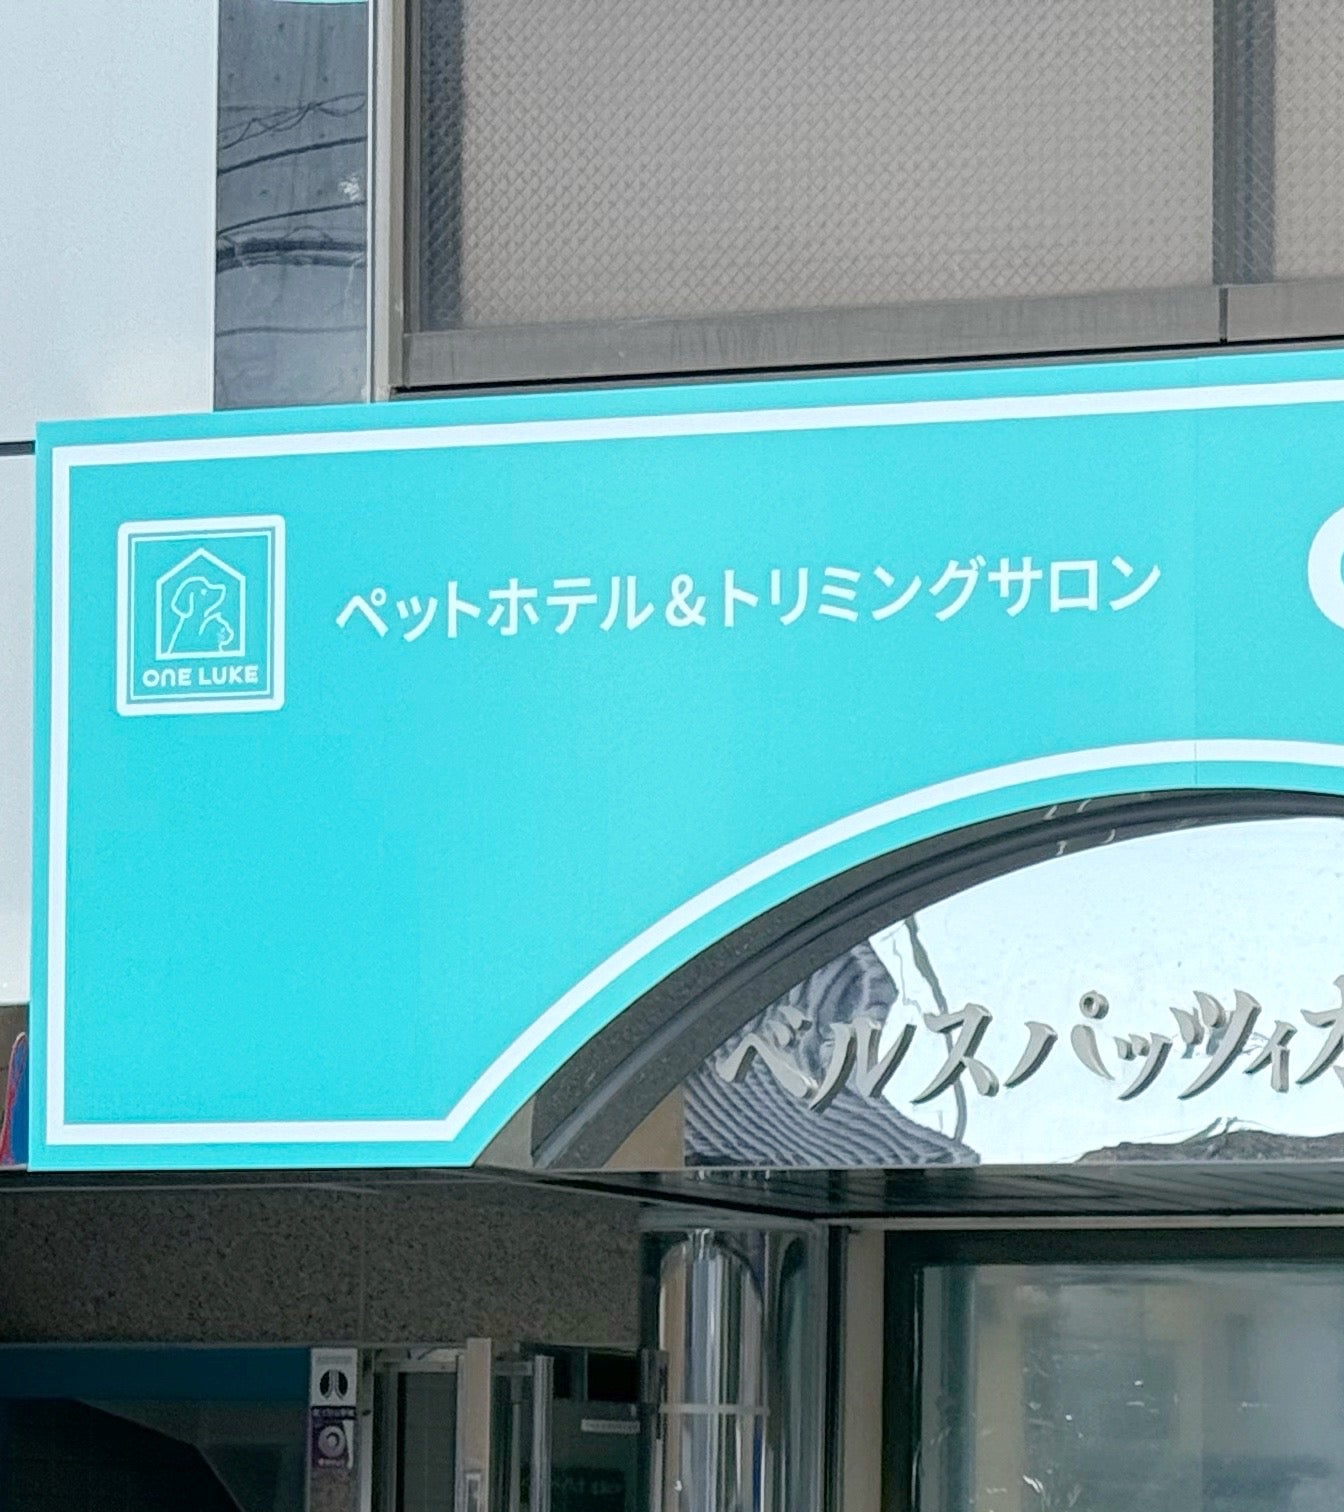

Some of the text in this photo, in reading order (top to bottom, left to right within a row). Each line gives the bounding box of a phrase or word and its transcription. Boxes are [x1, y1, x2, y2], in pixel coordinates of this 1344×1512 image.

[335, 554, 1163, 643] ペットホテル&トリミングサロン
[142, 665, 259, 688] ONE LUKE
